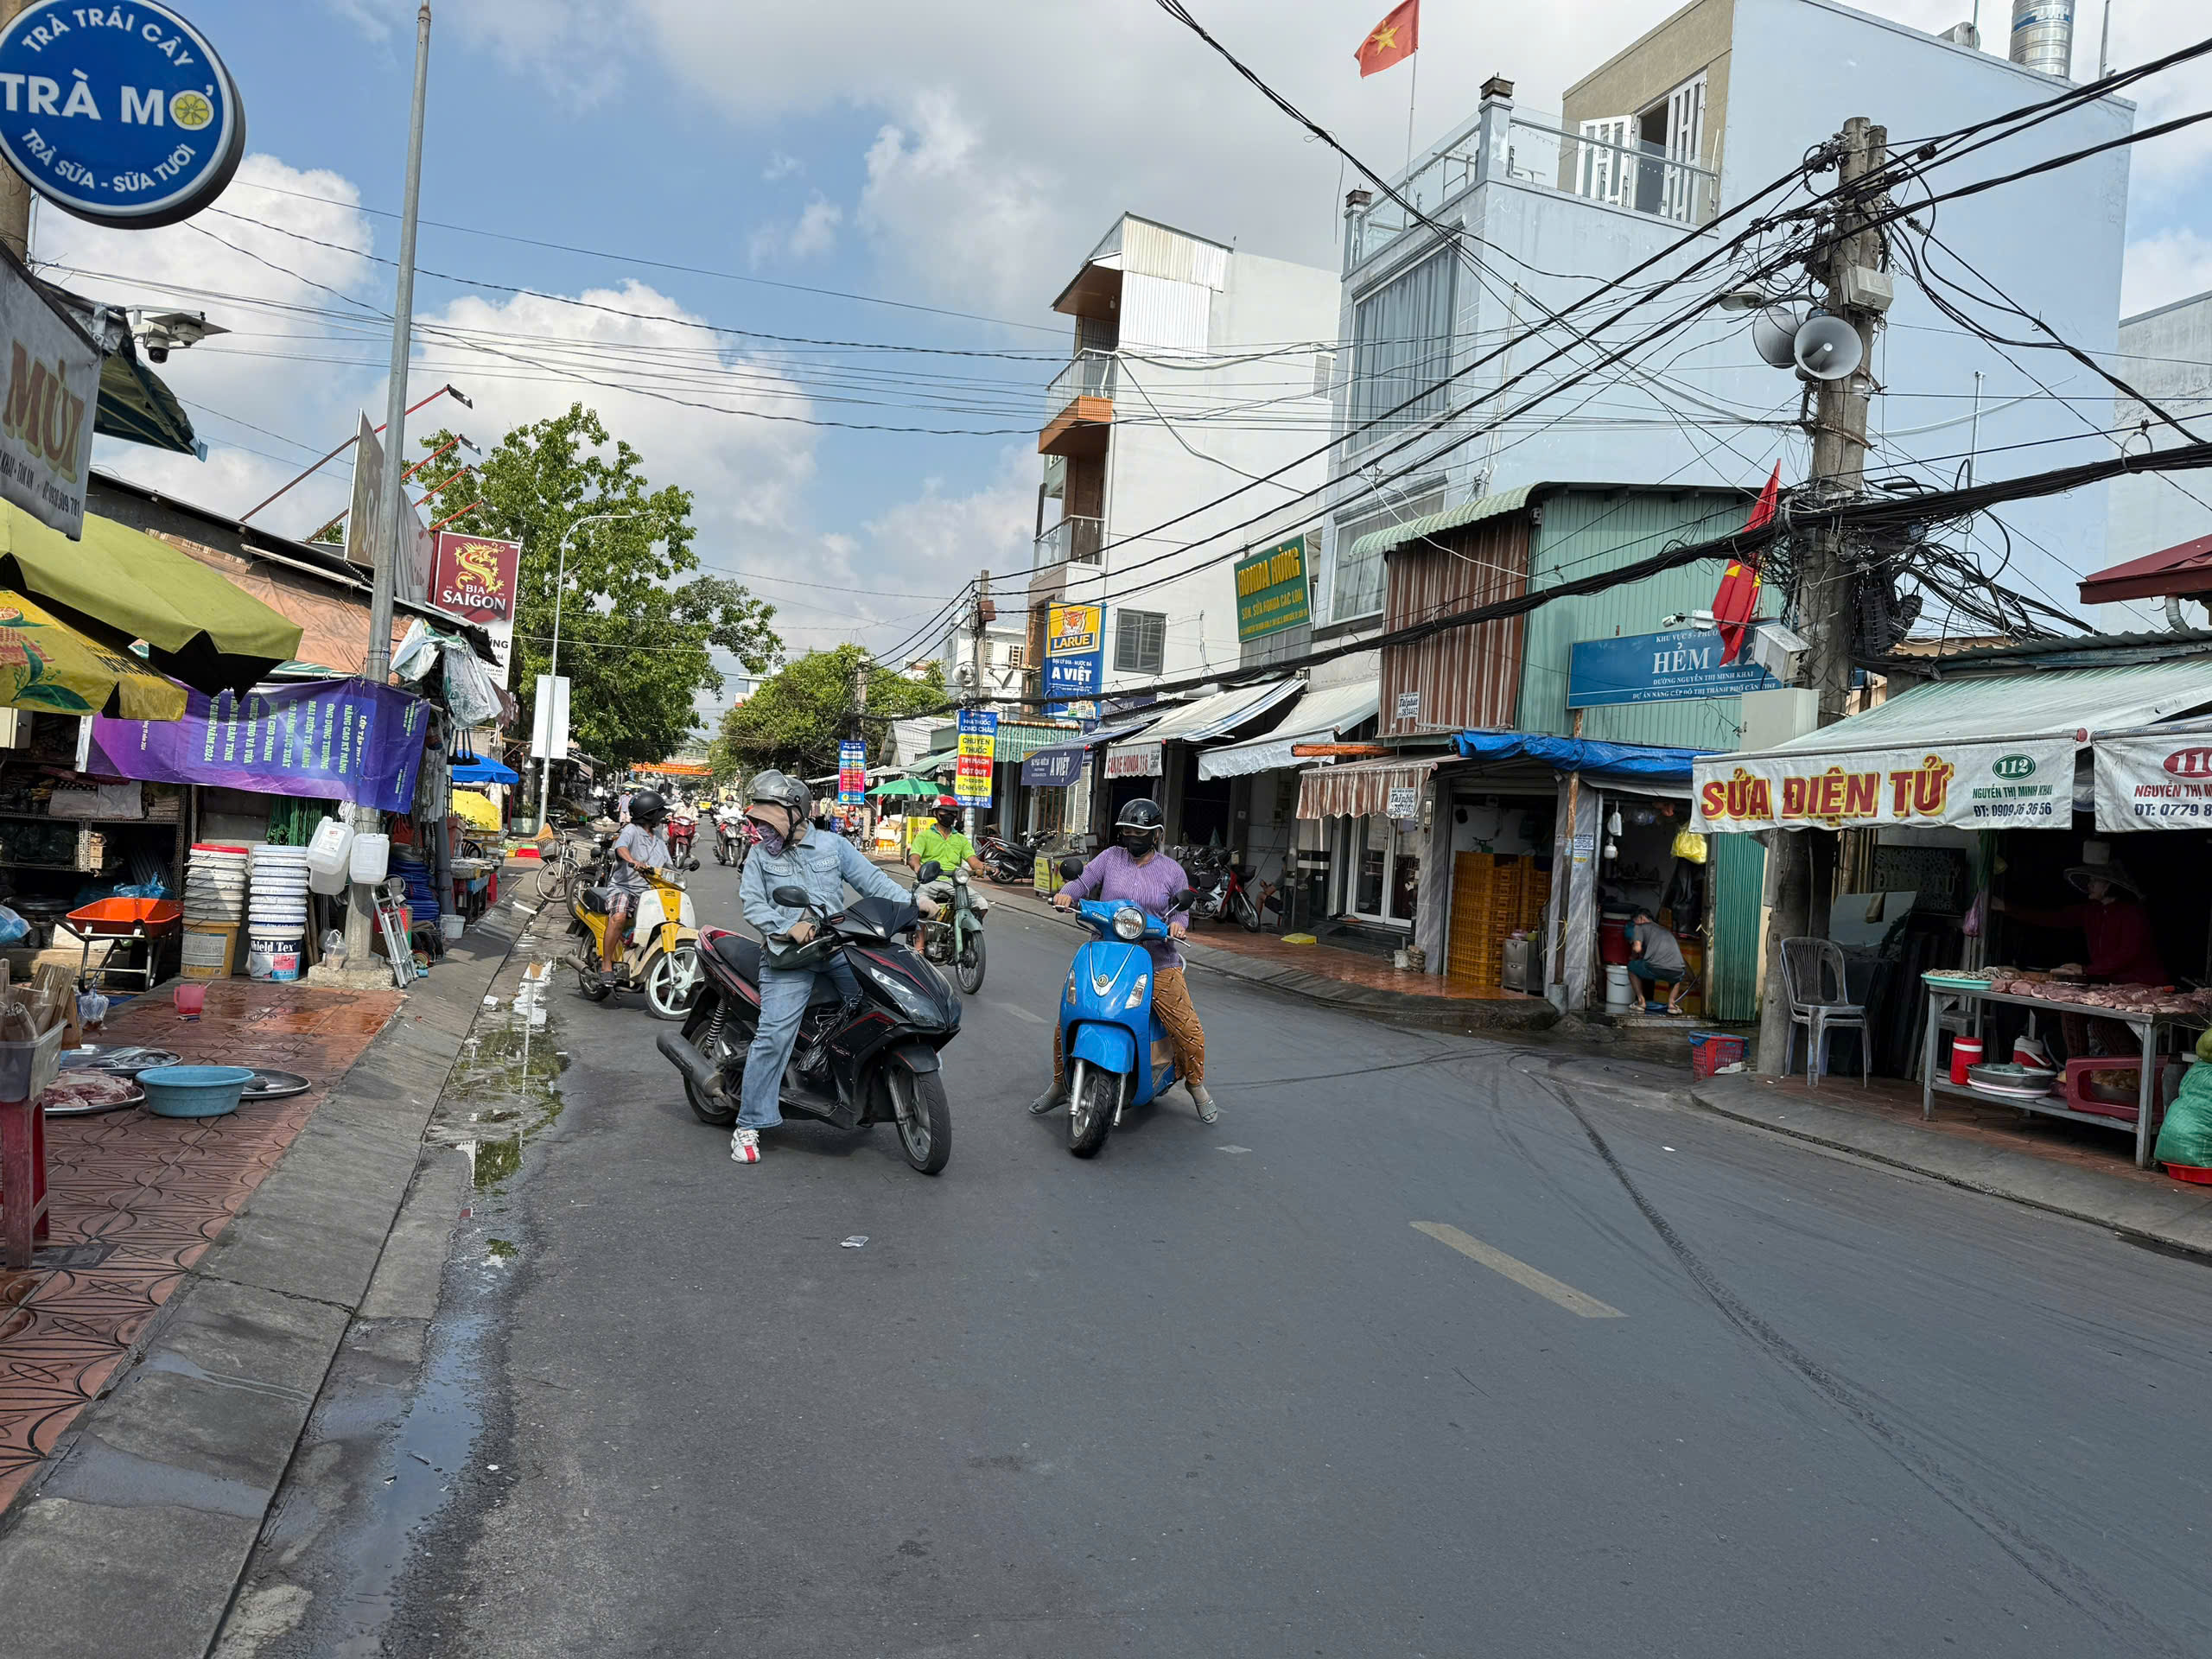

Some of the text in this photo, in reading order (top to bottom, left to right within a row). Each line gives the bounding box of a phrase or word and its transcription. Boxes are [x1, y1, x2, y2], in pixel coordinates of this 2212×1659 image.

[22, 6, 194, 67] TRÀ TRÁI CÂY
[0, 68, 102, 121] TRÀ
[22, 128, 57, 166] TRÀ
[54, 160, 95, 189] SỮA
[113, 171, 156, 192] SỮA
[154, 143, 197, 181] TƯƠI
[1238, 559, 1271, 598] HONDA
[466, 584, 485, 594] BIA
[442, 589, 506, 610] SAIGON
[1053, 634, 1090, 650] LARUE
[1656, 634, 1670, 643] KHU
[1652, 642, 1711, 674] HẺM
[1052, 666, 1092, 685] A VIỆT
[1677, 674, 1703, 683] NGUYỄN
[1707, 685, 1729, 694] THÀNH
[267, 721, 276, 734] CHO
[341, 727, 350, 740] CAO
[204, 745, 214, 761] 2024
[264, 736, 275, 761] DOANH
[1999, 759, 2029, 774] 112
[1700, 753, 1955, 828] SỬA ĐIỆN TỬ
[1972, 784, 2002, 799] NGUYỄN
[2003, 786, 2016, 799] THỊ
[2018, 785, 2038, 798] MINH
[2134, 779, 2182, 798] NGUYỄN
[2184, 784, 2202, 800] THỊ
[1974, 805, 1989, 817] ĐT:
[1992, 804, 2014, 817] 0909
[2026, 803, 2038, 815] 36
[2039, 802, 2052, 815] 56
[2135, 804, 2156, 816] ĐT:
[2160, 804, 2198, 816] 0779
